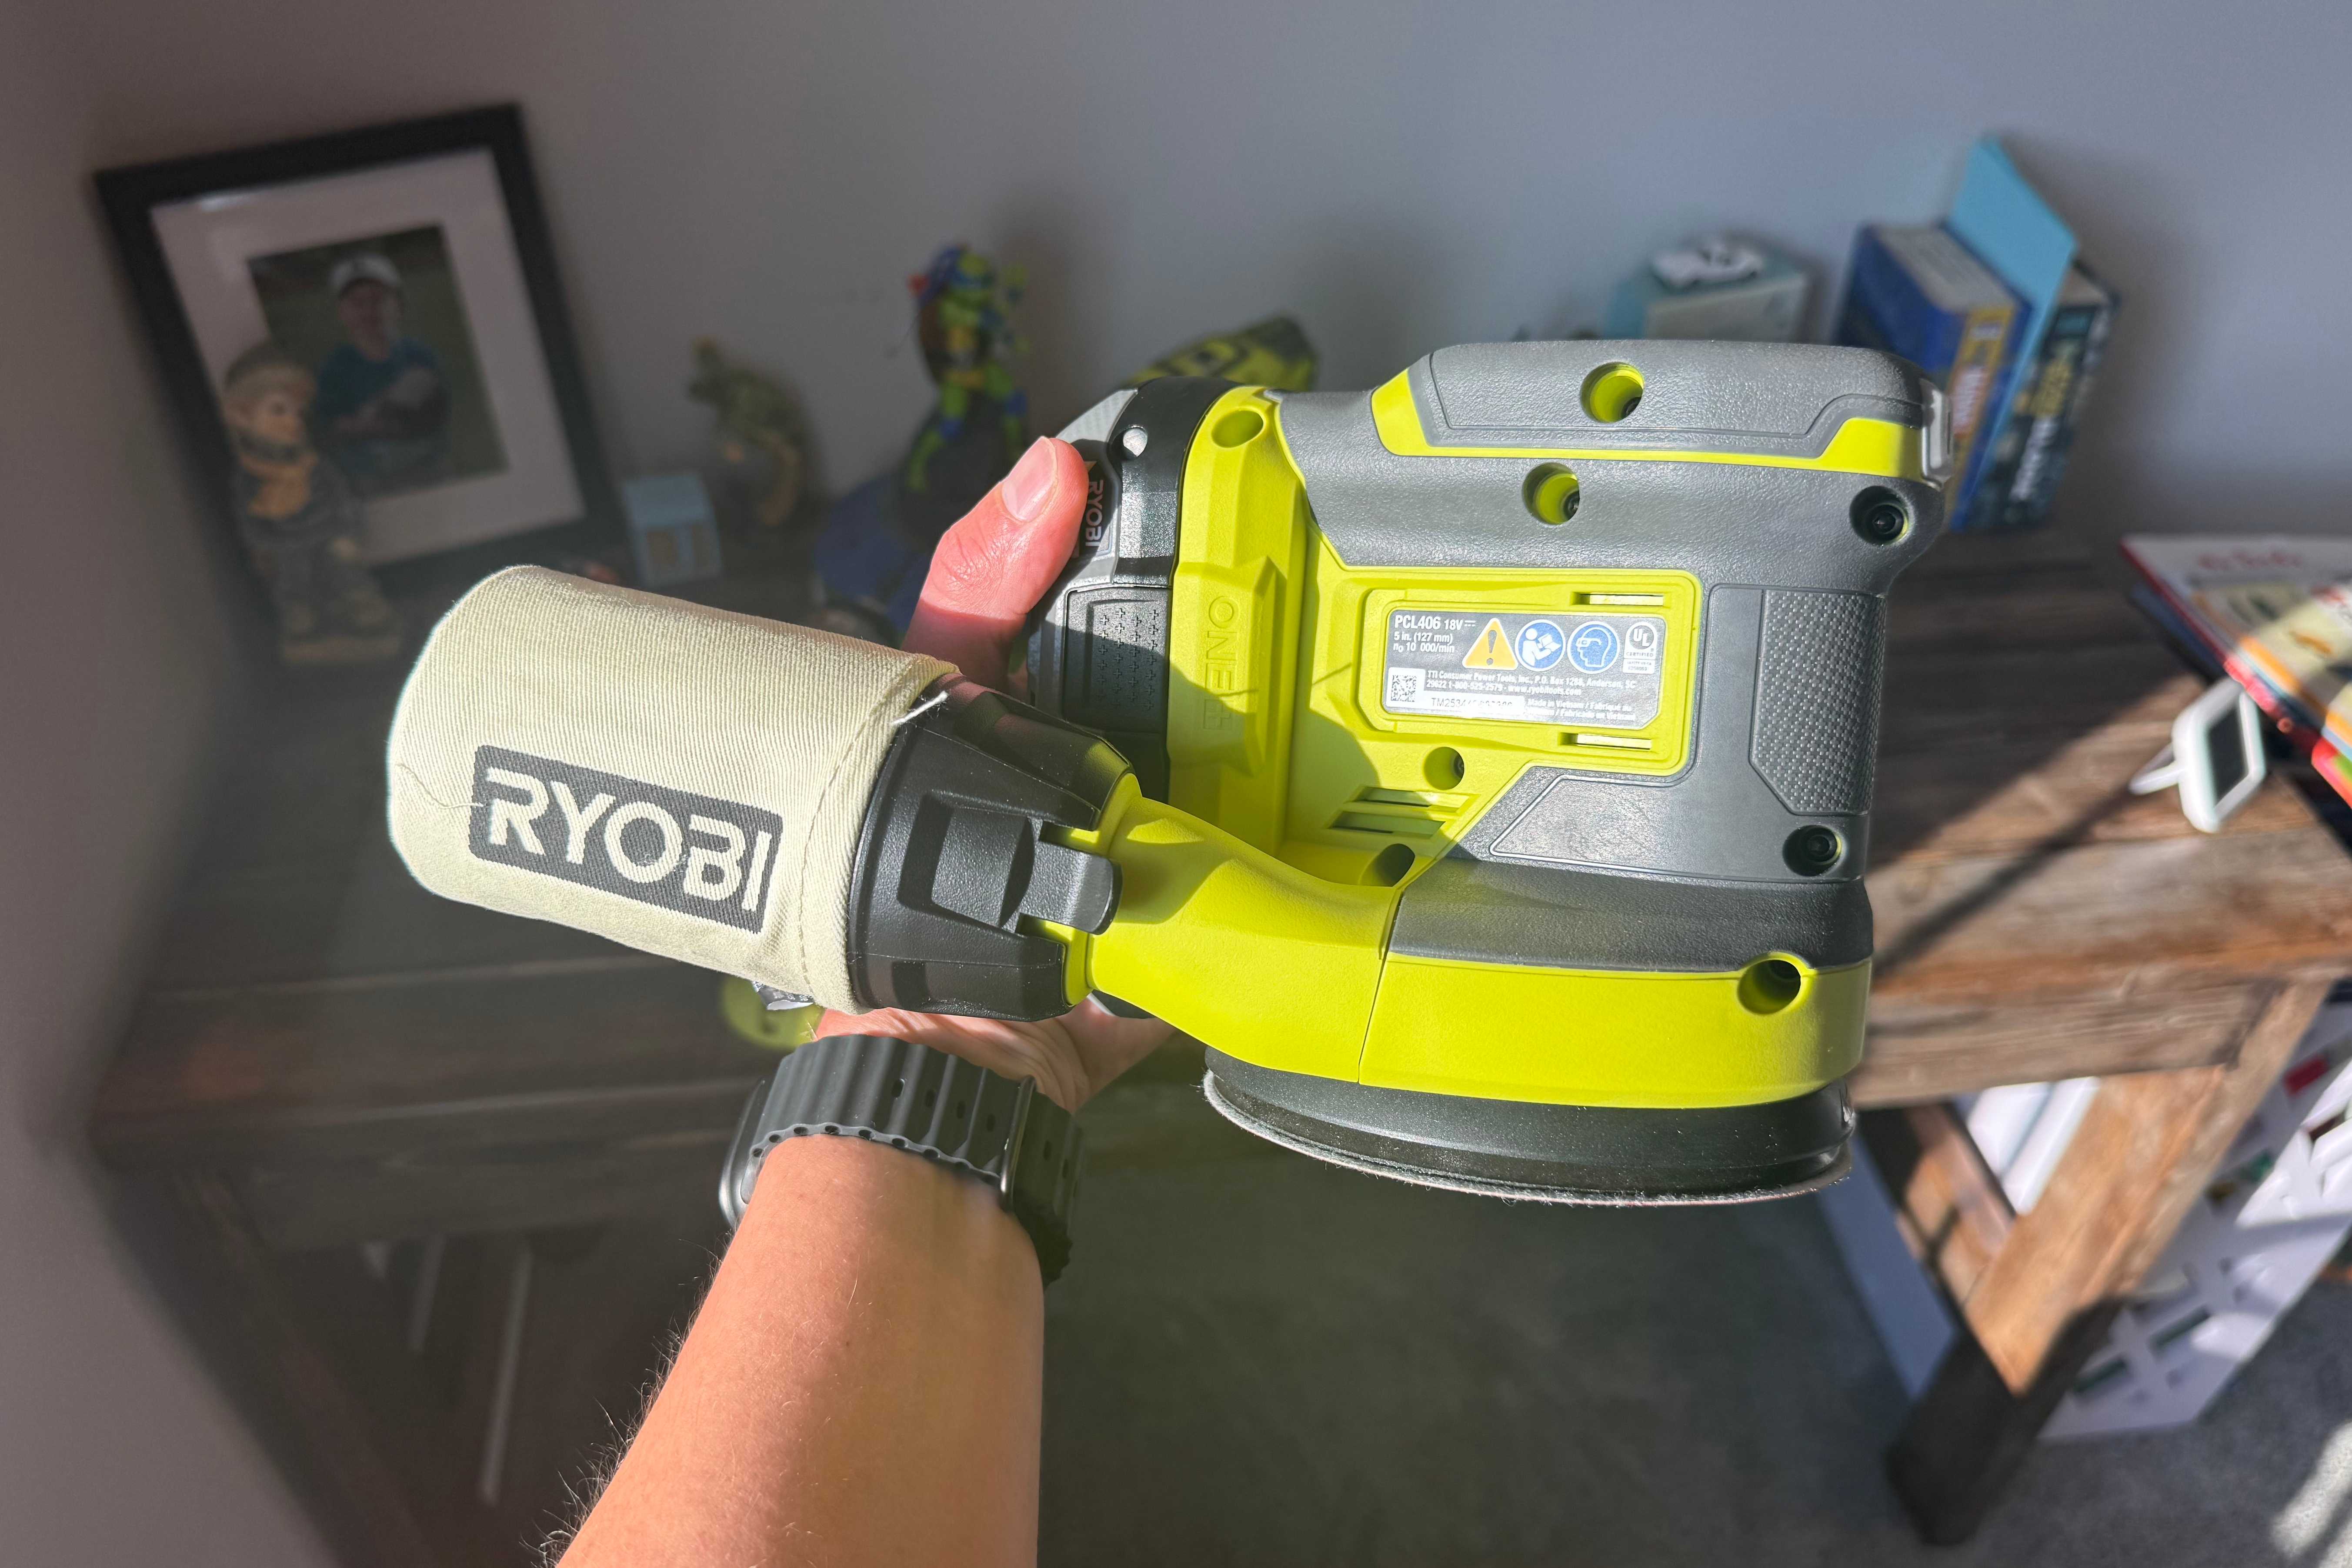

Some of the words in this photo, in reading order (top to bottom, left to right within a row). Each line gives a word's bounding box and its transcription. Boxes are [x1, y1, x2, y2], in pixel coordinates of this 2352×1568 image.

[1085, 480, 1104, 547] RYOBI
[1395, 615, 1441, 630] PCL406
[1444, 619, 1463, 631] 18V
[1394, 631, 1400, 641] 5
[1401, 631, 1412, 641] in.
[1413, 632, 1433, 643] (127
[1434, 633, 1453, 644] mm)
[1633, 628, 1650, 647] UL
[1439, 671, 1472, 681] Consumer
[1474, 672, 1496, 681] Power
[486, 767, 773, 912] RYOBI
